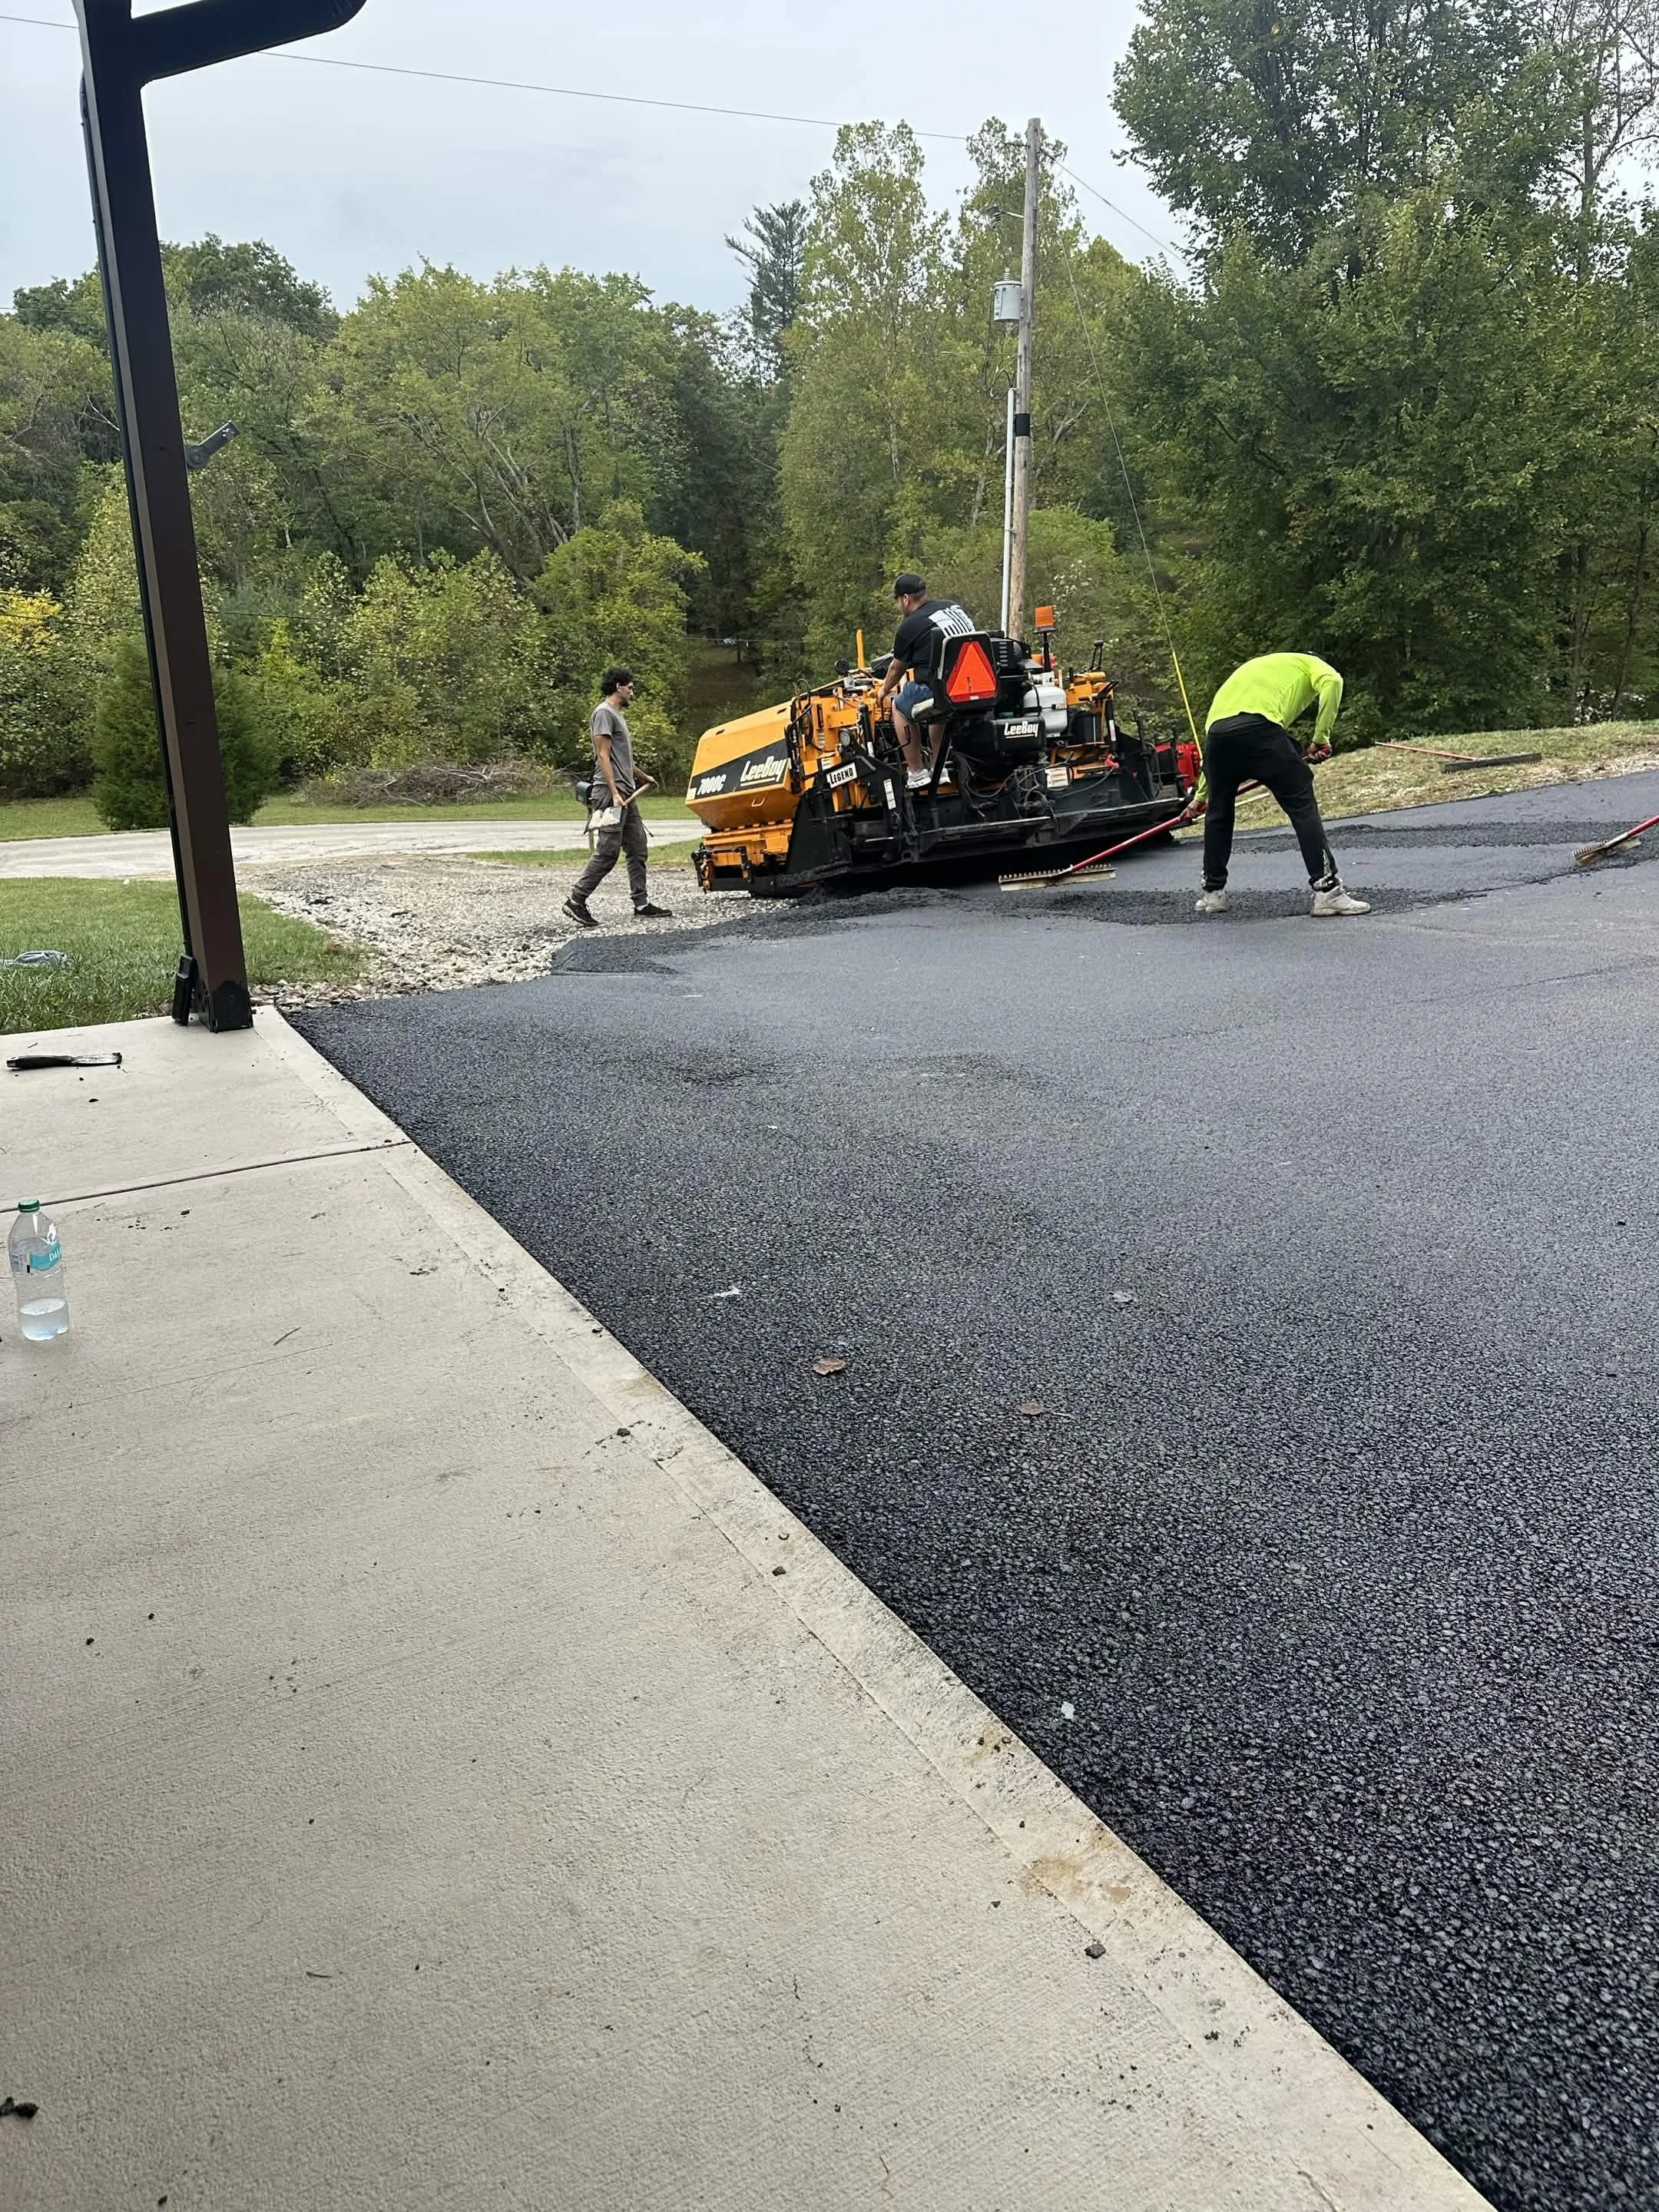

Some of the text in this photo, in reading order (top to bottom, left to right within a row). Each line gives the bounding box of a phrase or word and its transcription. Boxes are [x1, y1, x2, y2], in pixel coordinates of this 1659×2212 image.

[1004, 720, 1038, 737] LeeBoy
[740, 756, 787, 783] LeeBoy
[830, 767, 854, 784] LEGEND
[697, 774, 727, 796] 7000C
